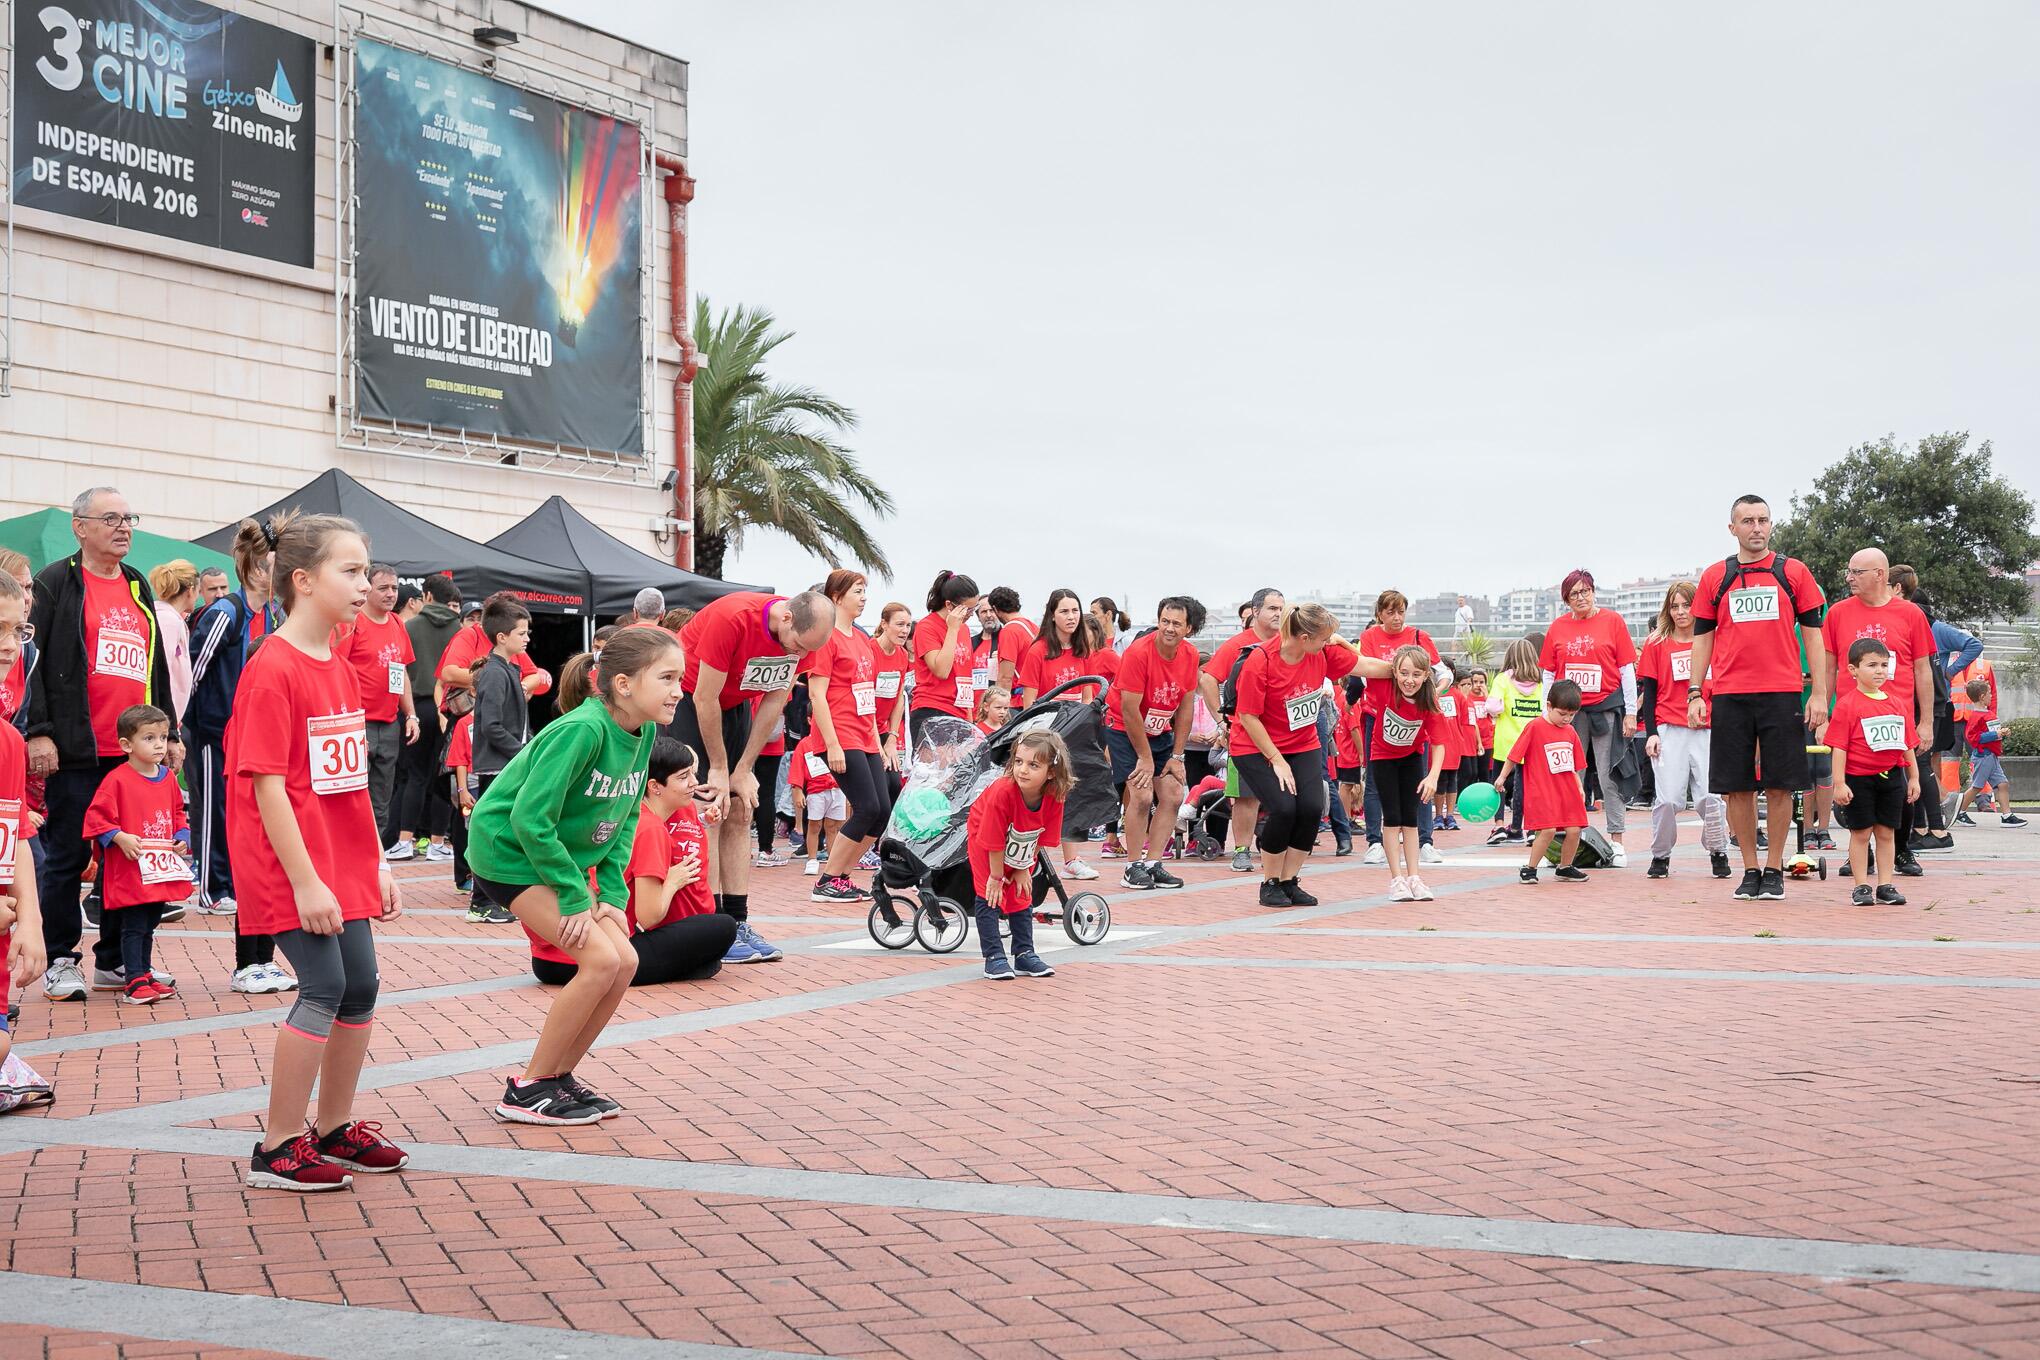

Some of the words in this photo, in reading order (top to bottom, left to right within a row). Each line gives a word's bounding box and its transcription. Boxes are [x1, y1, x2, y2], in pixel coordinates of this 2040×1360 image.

[96, 19, 186, 74] MEJOR
[92, 54, 188, 119] CINE
[203, 80, 255, 109] Getxo
[212, 106, 296, 151] zinemak
[421, 124, 441, 142] TODO
[441, 130, 458, 146] POR
[433, 113, 445, 128] SE
[38, 121, 194, 182] INDEPENDIENTE
[32, 156, 60, 185] DE
[67, 165, 147, 206] ESPAÑA
[153, 185, 198, 218] 2016
[369, 296, 439, 347] VIENTO
[442, 310, 467, 351] DE
[470, 316, 553, 368] LIBERTAD
[1735, 595, 1773, 614] 2007
[104, 643, 145, 671] 3003
[748, 664, 791, 684] 2013
[1383, 718, 1417, 740] 2007
